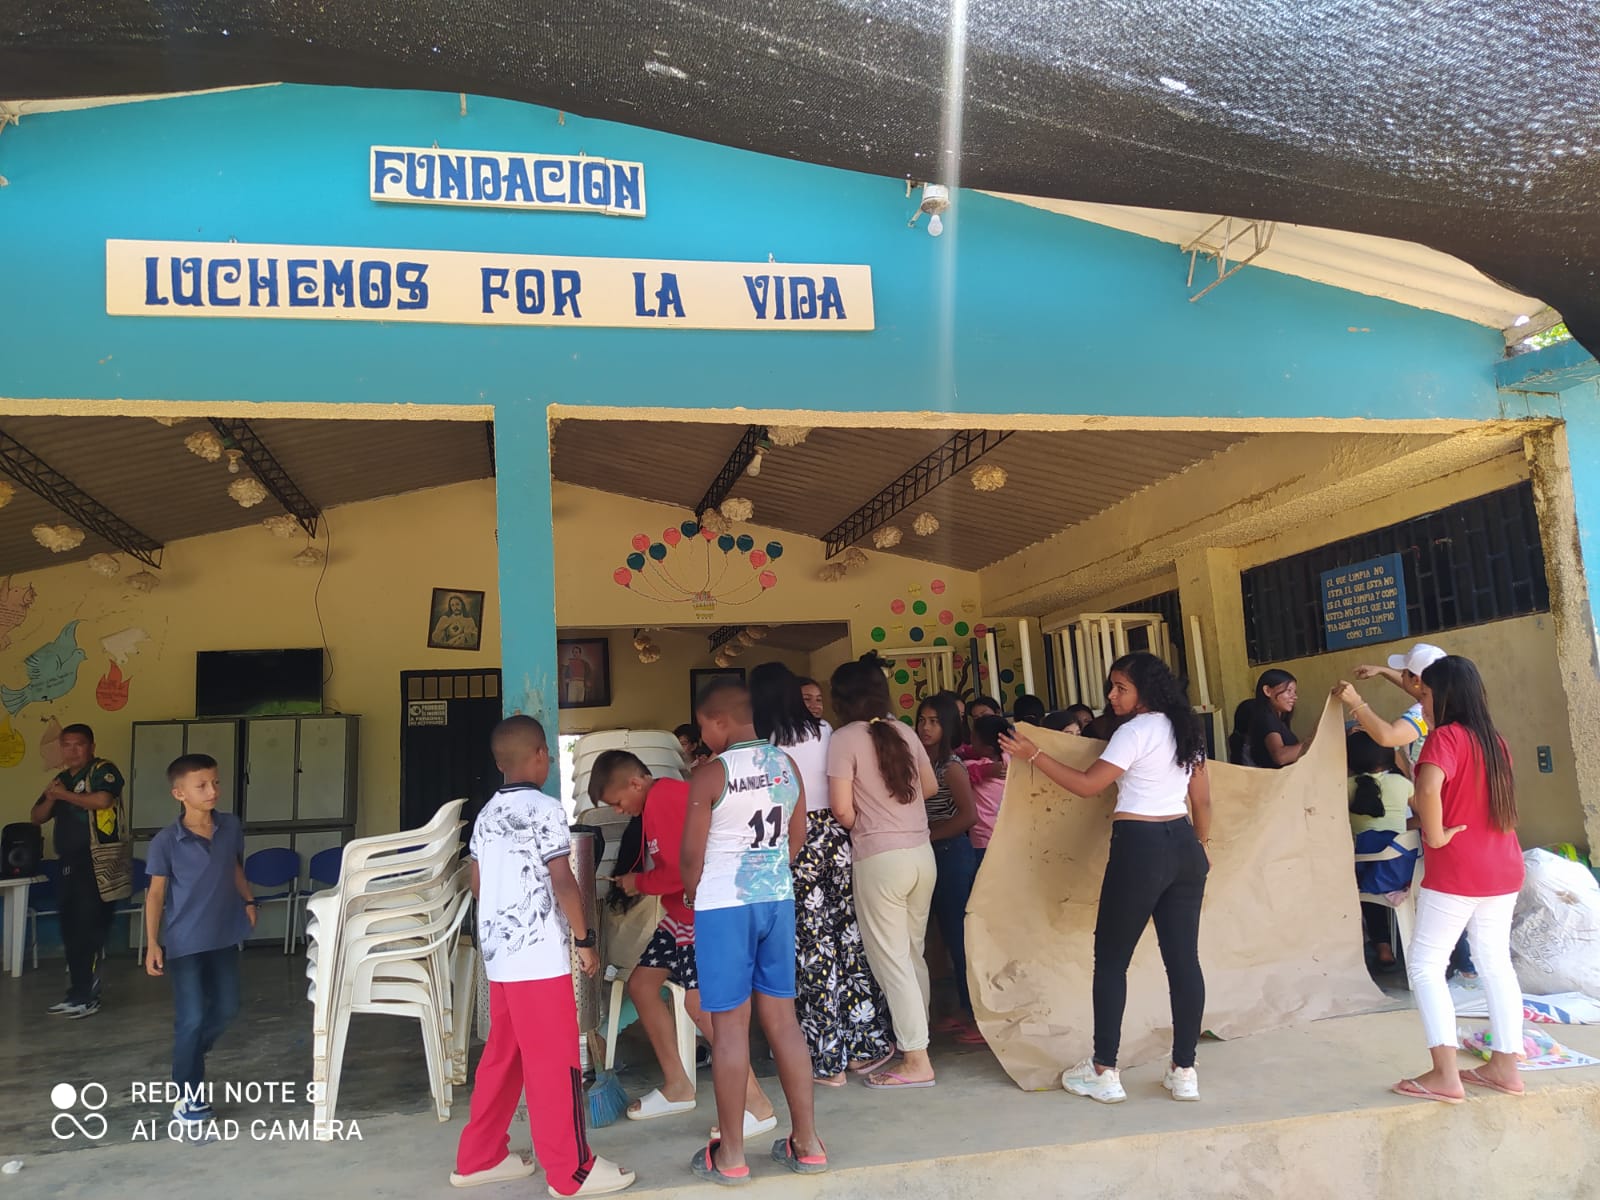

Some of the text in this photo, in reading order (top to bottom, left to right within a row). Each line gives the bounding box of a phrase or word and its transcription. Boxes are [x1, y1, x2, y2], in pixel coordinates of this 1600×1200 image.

[374, 150, 640, 210] FUNDACION
[145, 257, 847, 320] LUCHEMOS POR LA VIDA
[1327, 579, 1334, 587] EL
[1348, 570, 1371, 581] LIMPIA
[1374, 566, 1384, 575] NO
[1383, 576, 1394, 586] NO
[1353, 593, 1375, 602] LIMPIA
[1375, 591, 1381, 600] Y
[1344, 608, 1354, 618] NO
[1383, 600, 1396, 609] LIM
[1352, 616, 1370, 627] TODO
[1372, 612, 1395, 623] LIMPIO
[728, 773, 773, 794] MANUEL
[748, 805, 782, 848] 11
